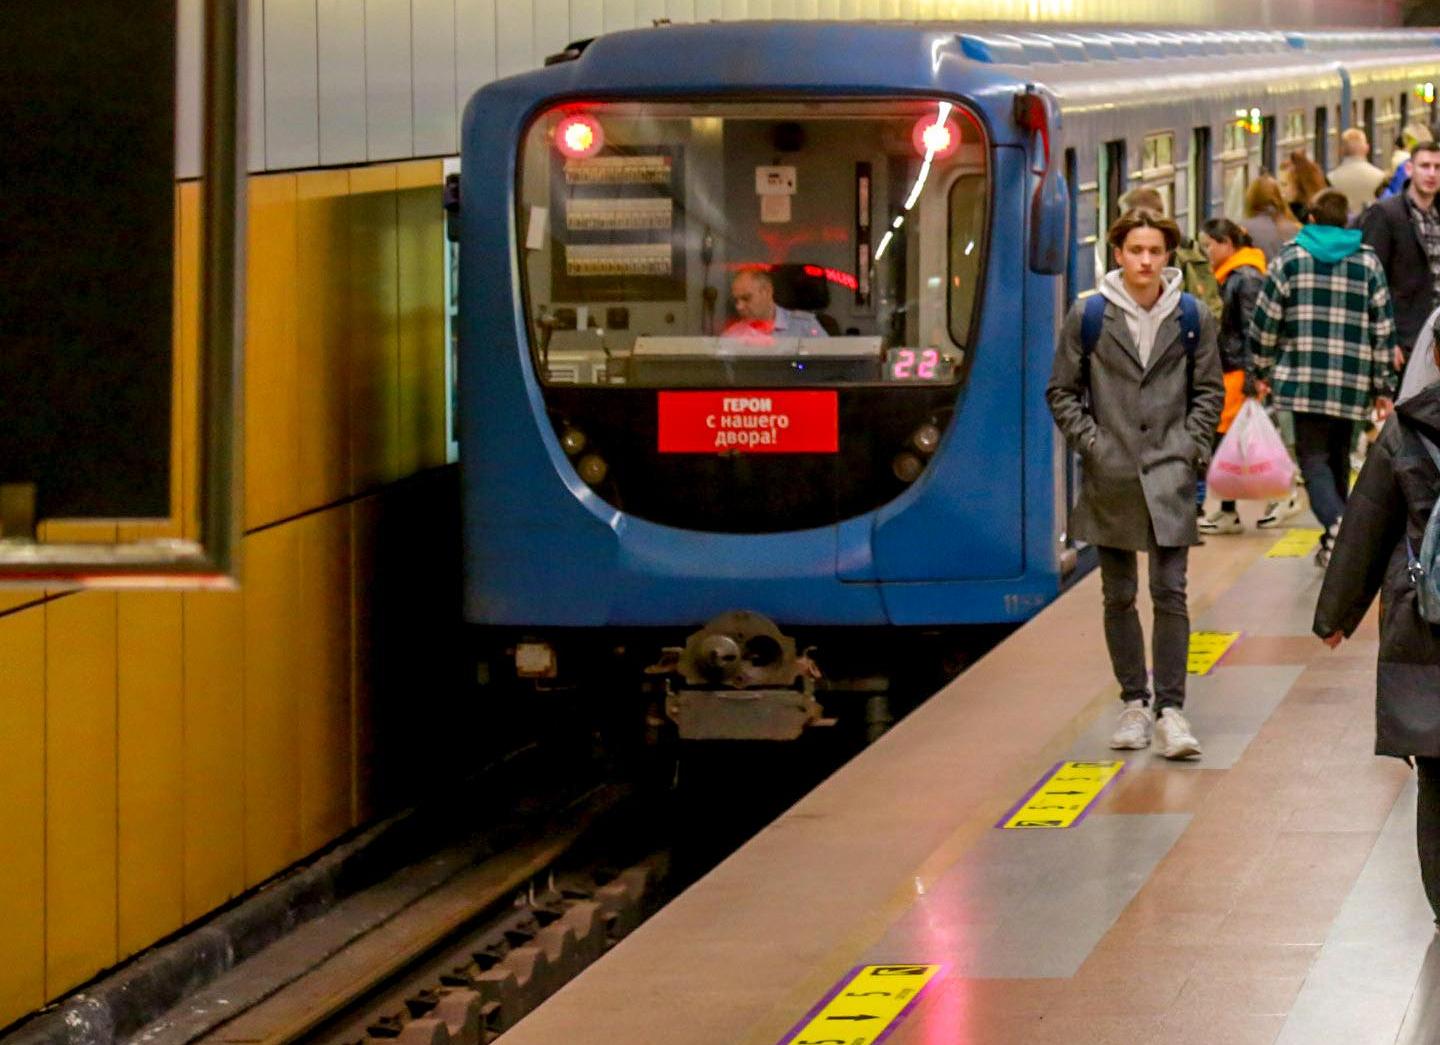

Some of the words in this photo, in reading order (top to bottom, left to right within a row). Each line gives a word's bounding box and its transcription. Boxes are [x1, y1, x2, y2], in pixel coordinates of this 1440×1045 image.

[895, 350, 938, 378] 22
[723, 397, 773, 412] ГЕРОИ
[706, 414, 716, 429] с
[721, 414, 790, 429] нашего
[714, 427, 777, 448] двора!
